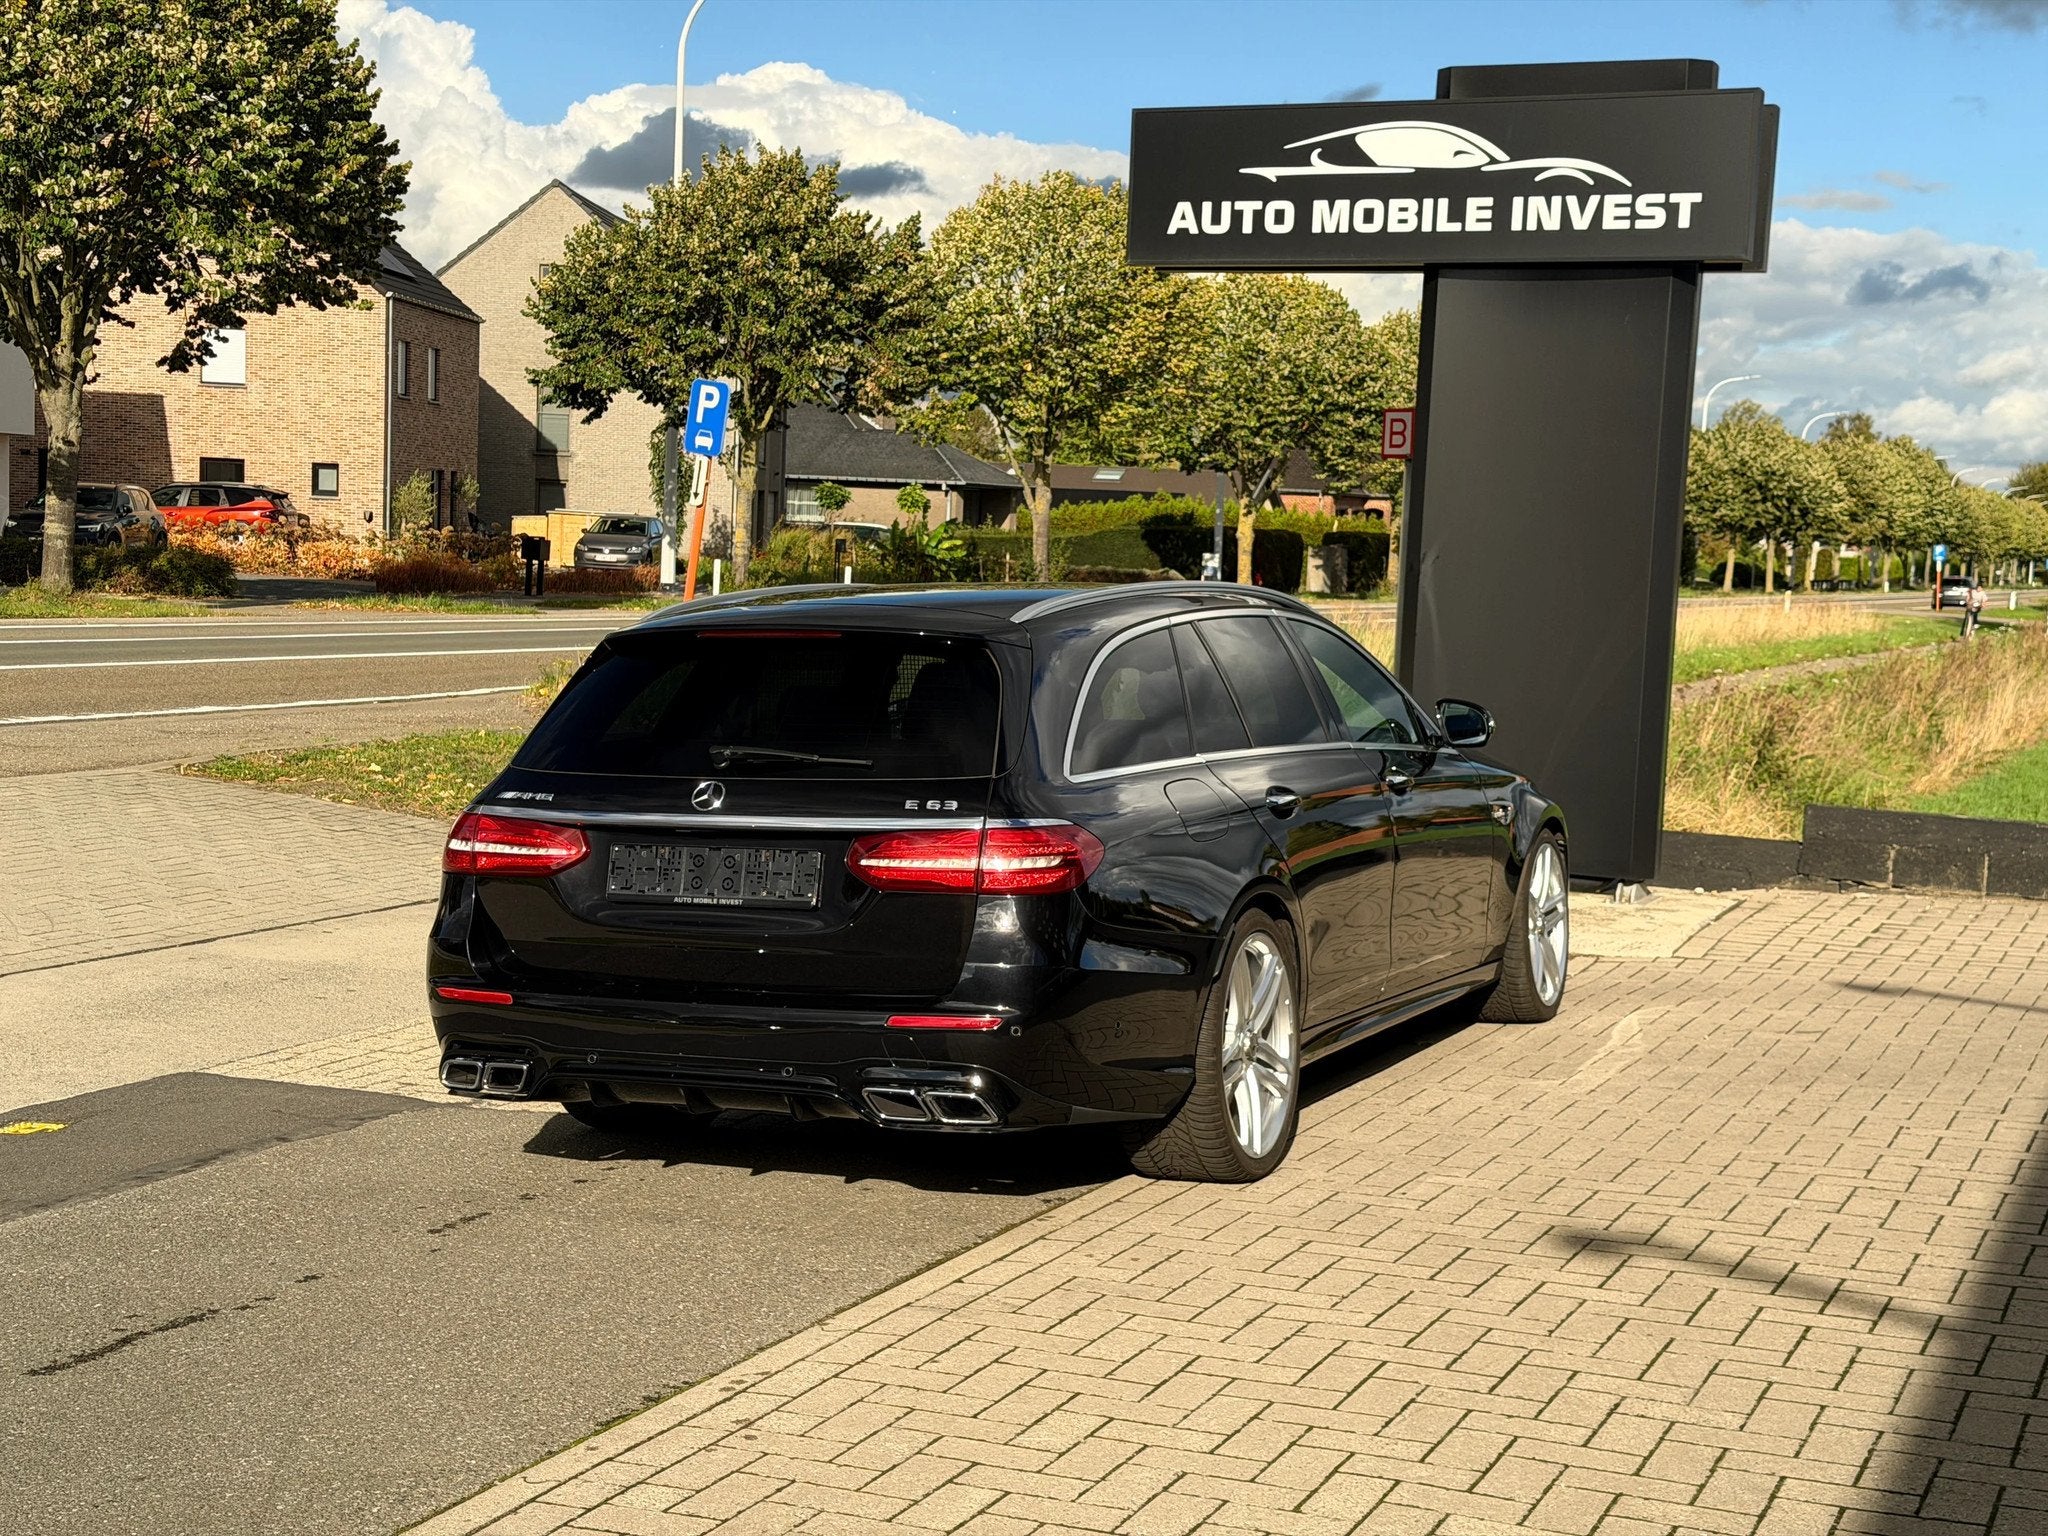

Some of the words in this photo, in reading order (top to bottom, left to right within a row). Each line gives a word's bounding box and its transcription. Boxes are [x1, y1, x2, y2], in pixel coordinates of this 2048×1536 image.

[1166, 199, 1295, 235] AUTO
[1311, 197, 1494, 234] MOBILE
[1510, 192, 1703, 232] INVEST
[696, 384, 720, 423] P
[1389, 418, 1407, 448] B
[513, 791, 554, 801] AMG
[904, 799, 920, 810] E
[925, 799, 959, 811] 63
[673, 896, 692, 904] AUTO
[693, 897, 717, 905] MOBILE
[719, 898, 743, 906] INVEST
